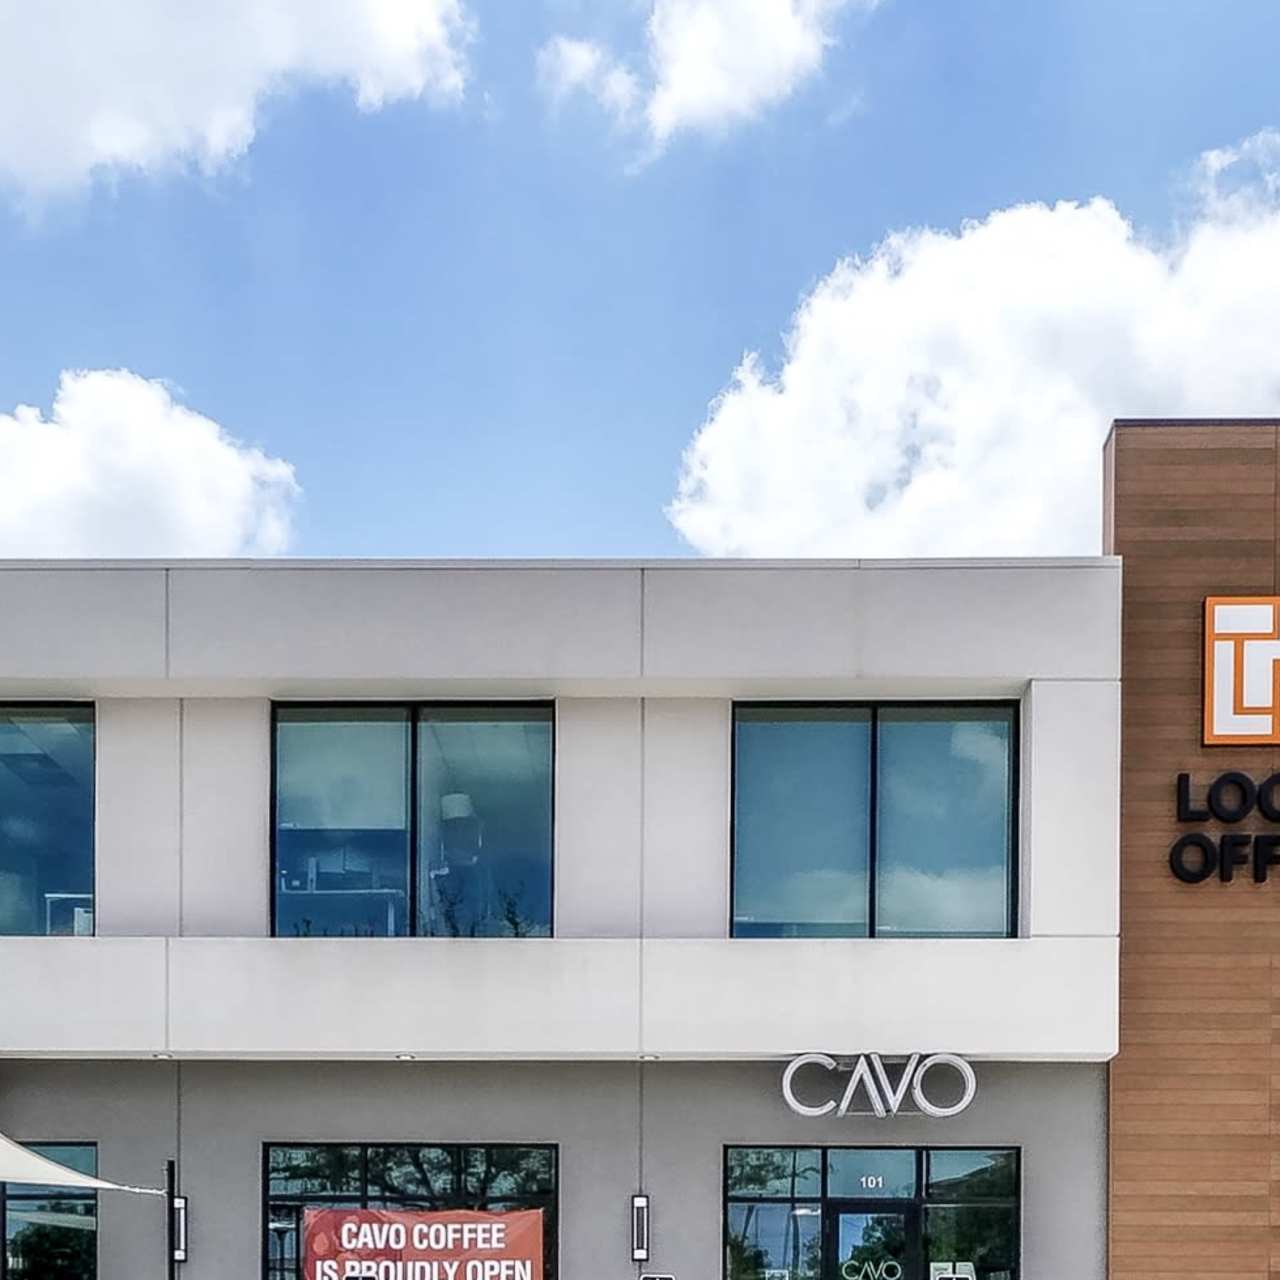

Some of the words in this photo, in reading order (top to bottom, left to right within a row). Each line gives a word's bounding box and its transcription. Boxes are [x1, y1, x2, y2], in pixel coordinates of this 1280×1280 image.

[782, 1053, 977, 1117] CAVO
[860, 1176, 884, 1188] 101
[341, 1223, 407, 1250] CAVO
[412, 1223, 506, 1249] COFFEE
[841, 1260, 902, 1280] CAVO
